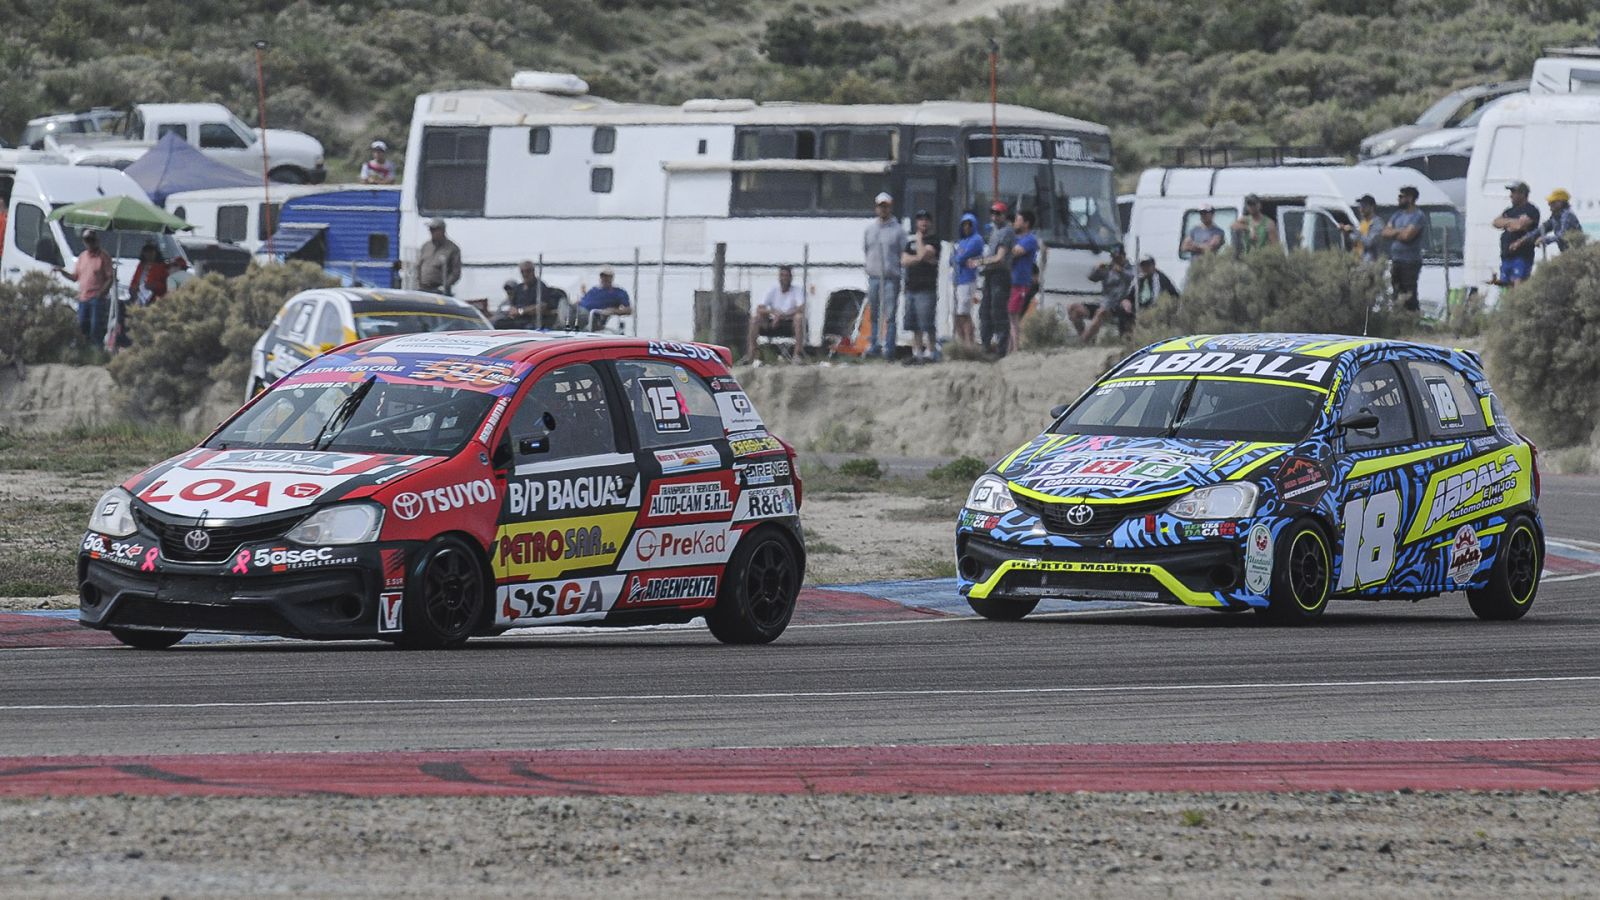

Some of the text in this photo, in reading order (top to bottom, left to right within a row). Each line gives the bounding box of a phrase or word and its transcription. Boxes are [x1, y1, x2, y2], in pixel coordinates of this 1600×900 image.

[1113, 352, 1332, 383] ABDALA
[647, 387, 680, 420] 15
[1430, 384, 1457, 420] 18
[140, 479, 271, 507] LOA
[661, 483, 720, 495] TRANSPORTE Y SERVICIOS
[975, 487, 992, 500] 18
[1044, 478, 1131, 487] CARSERVICE
[1424, 454, 1521, 533] ABDALA
[1483, 477, 1516, 499] E HIJOS
[508, 478, 545, 517] B/P
[651, 491, 732, 514] AUTO-CAM S.R.L.
[749, 494, 783, 516] R&G
[1448, 496, 1504, 519] Automotores
[660, 529, 726, 557] PreKad
[1336, 489, 1401, 592] 18
[254, 547, 333, 566] 5asec
[287, 556, 358, 569] TEXTILE EXPERT
[1011, 562, 1151, 573] PUERTO MADRYN
[645, 576, 718, 600] ARGENPENTA
